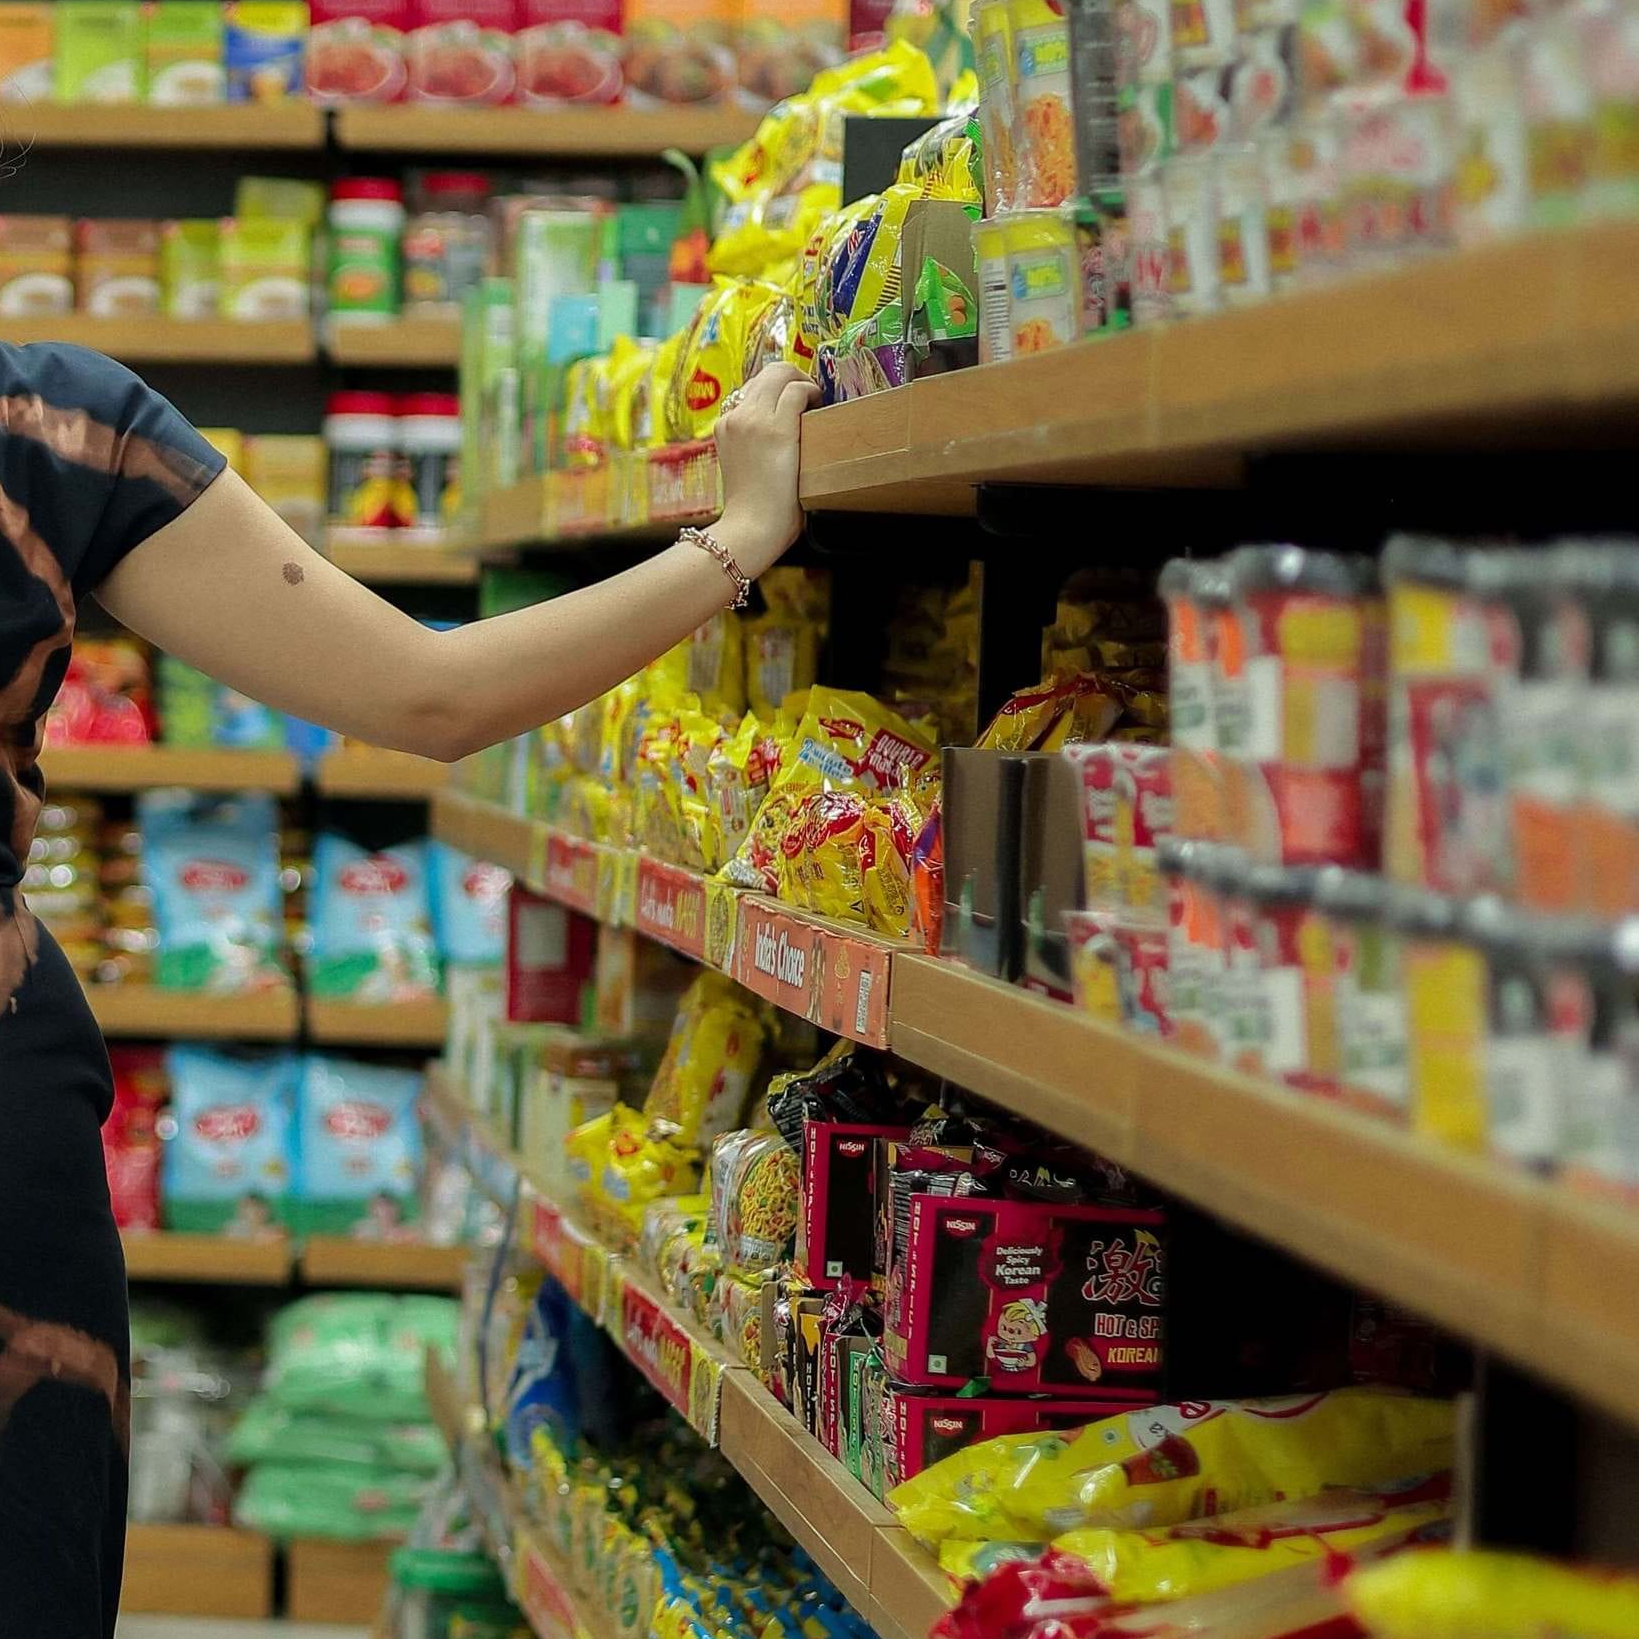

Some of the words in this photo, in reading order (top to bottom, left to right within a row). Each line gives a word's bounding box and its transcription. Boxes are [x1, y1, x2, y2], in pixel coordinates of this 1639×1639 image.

[777, 930, 805, 989] Choice
[839, 1141, 865, 1152] NISSIN
[946, 1219, 976, 1232] NISSIN
[996, 1246, 1043, 1257] Deliciously
[1006, 1254, 1031, 1267] Spicy
[995, 1264, 1041, 1276] Korean
[1004, 1276, 1030, 1285] Taste
[1094, 1313, 1124, 1337] HOT
[933, 1418, 963, 1430] NISSIN
